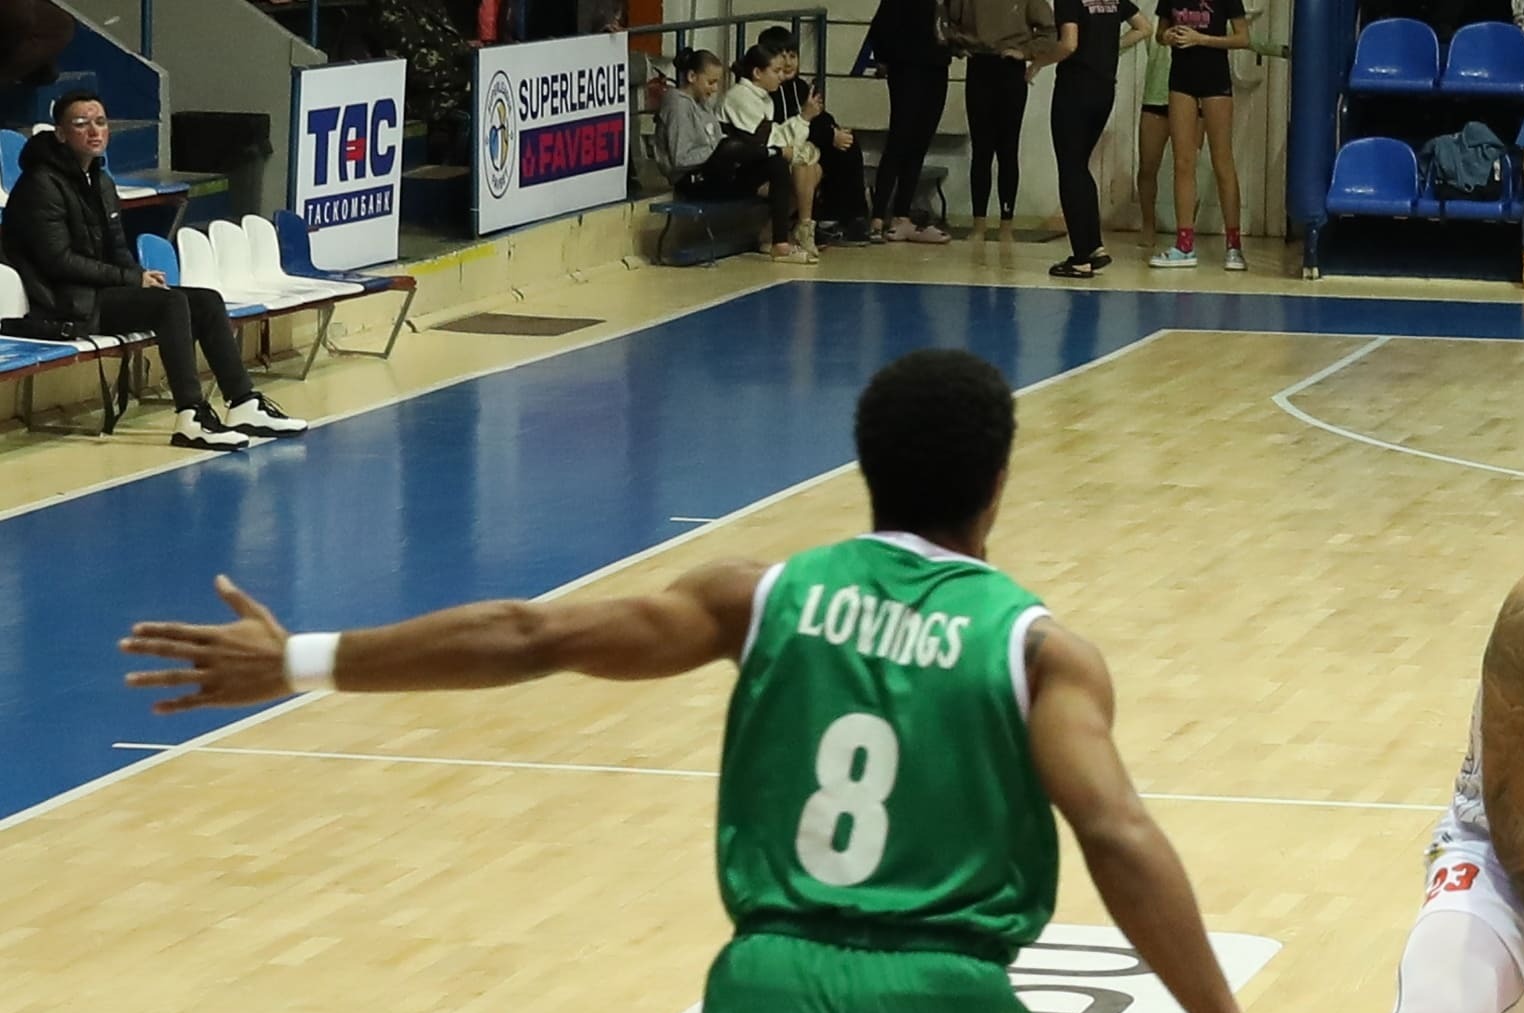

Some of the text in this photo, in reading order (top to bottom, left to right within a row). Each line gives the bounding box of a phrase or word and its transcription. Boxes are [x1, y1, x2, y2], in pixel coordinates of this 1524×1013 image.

[519, 63, 625, 121] SUPERLEAGUE
[538, 119, 623, 175] FAVBET
[307, 191, 391, 225] ТАСКОМБАНК
[797, 584, 970, 669] LOVINGS
[795, 712, 899, 886] 8
